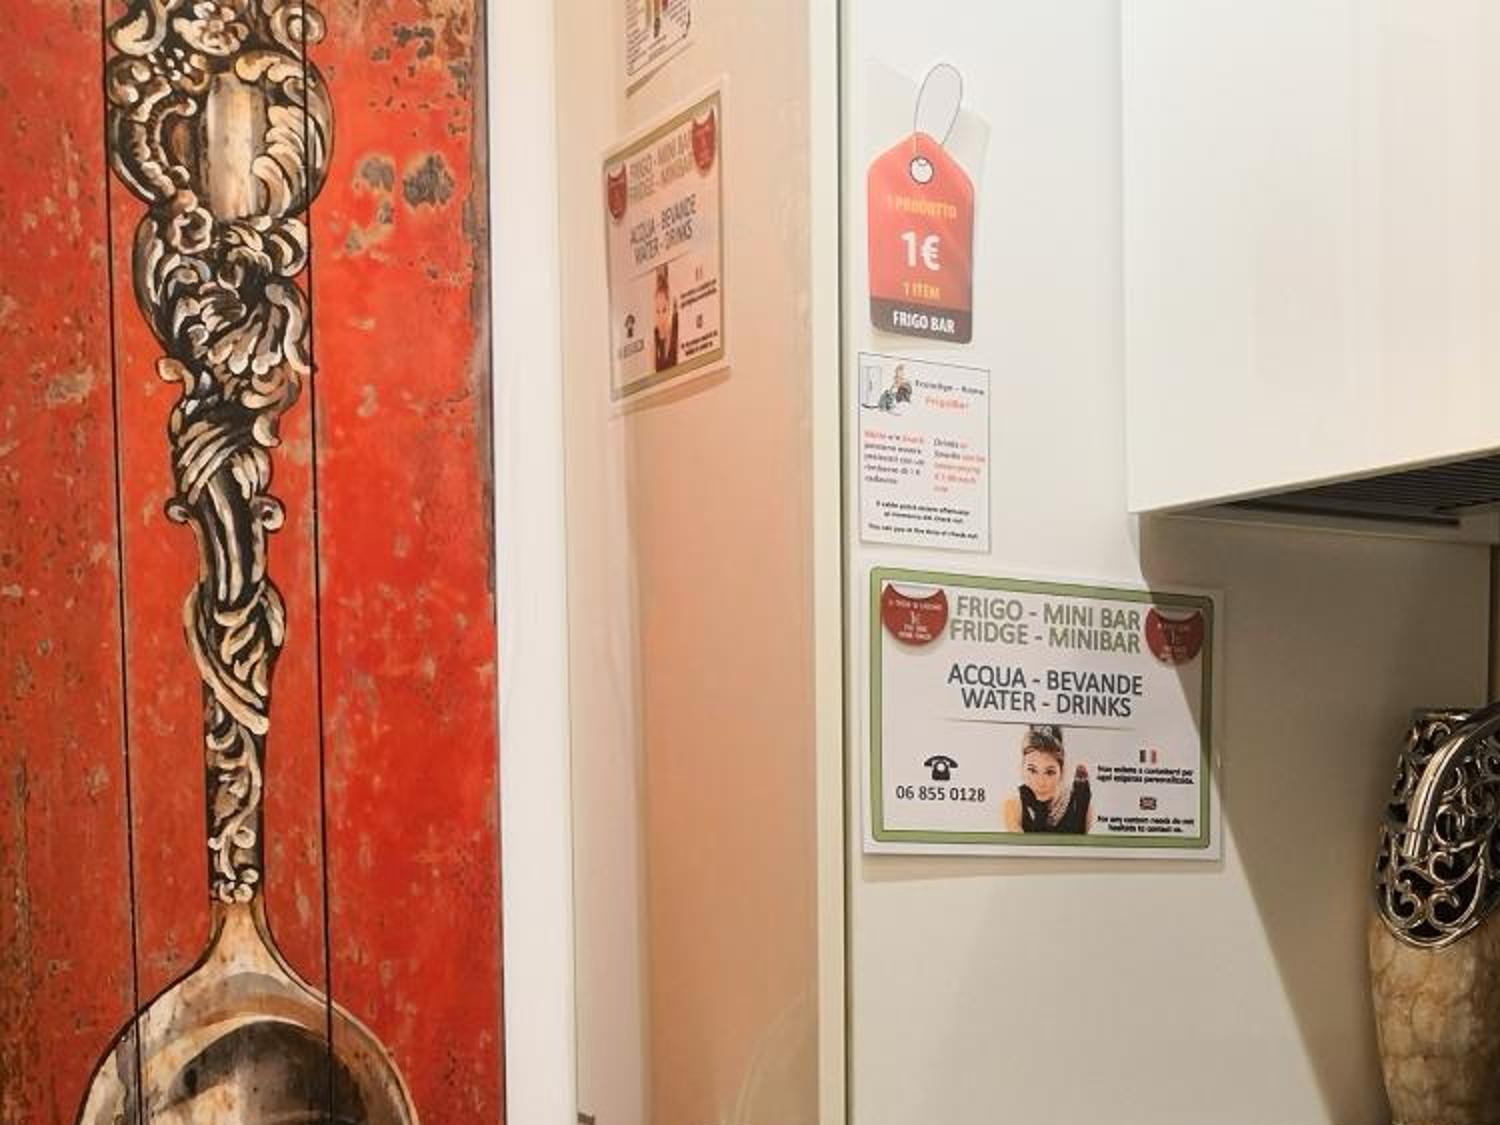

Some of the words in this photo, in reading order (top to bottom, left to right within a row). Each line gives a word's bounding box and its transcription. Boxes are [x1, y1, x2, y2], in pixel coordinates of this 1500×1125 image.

[893, 310, 928, 329] FRIGO
[931, 316, 955, 334] BAR
[956, 595, 1023, 622] FRIGO
[1044, 603, 1093, 627] MINI
[1101, 608, 1140, 632] BAR
[950, 619, 1028, 645] FRIDGE
[1049, 627, 1140, 653] MINIBAR
[948, 663, 1026, 690] ACQUA
[1047, 670, 1143, 696] BEVANDE
[961, 687, 1036, 712] WATER
[1056, 694, 1131, 717] DRINKS
[895, 785, 915, 800] 06
[917, 786, 945, 801] 855
[950, 787, 985, 803] 0128
